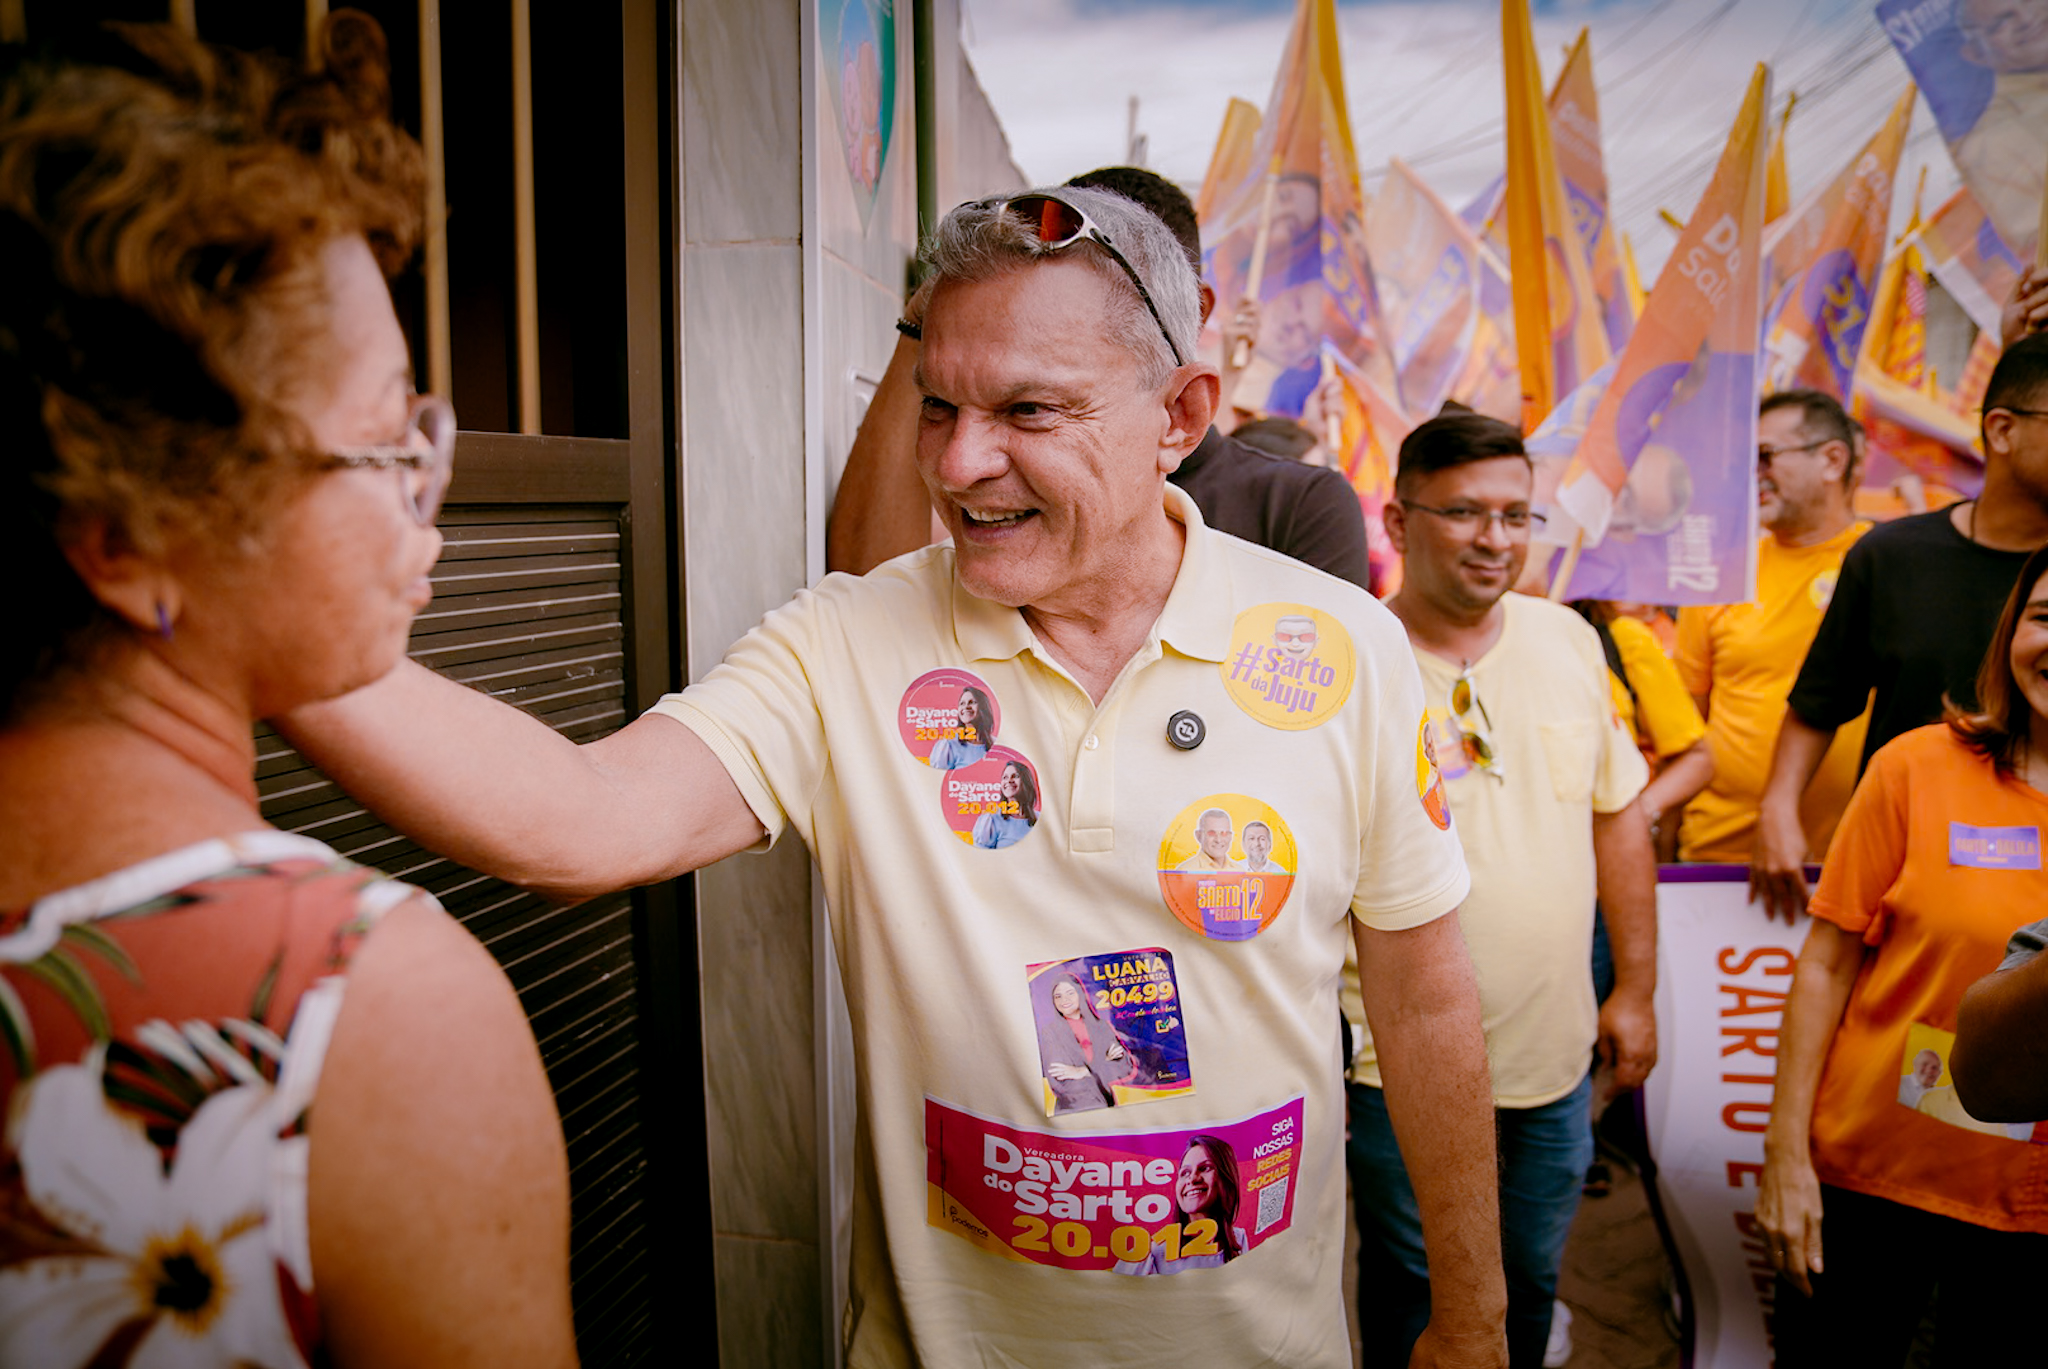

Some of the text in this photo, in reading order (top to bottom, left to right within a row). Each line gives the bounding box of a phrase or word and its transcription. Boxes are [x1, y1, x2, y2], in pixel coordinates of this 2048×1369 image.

[1667, 565, 1719, 592] 12
[1230, 642, 1335, 687] #Sarto
[1250, 674, 1318, 713] da Juju
[906, 706, 959, 719] Dayane
[915, 717, 959, 728] Sarto
[915, 727, 977, 741] 20.012
[949, 780, 1001, 794] Dayane
[958, 791, 1001, 802] Sarto
[957, 801, 1020, 815] 20.012
[1197, 877, 1264, 921] SARTO 12
[1092, 957, 1168, 981] LUANA
[1108, 971, 1170, 988] CARVALHO
[1095, 981, 1176, 1009] 20499
[1271, 1116, 1294, 1136] SIGA
[1023, 1147, 1085, 1161] Vereadora
[1252, 1132, 1294, 1159] NOSSAS
[983, 1133, 1175, 1191] Dayane
[1257, 1147, 1293, 1173] REDES
[1246, 1163, 1290, 1192] SOCIAIS
[983, 1173, 1172, 1223] do Sarto
[951, 1215, 989, 1238] podemos
[1011, 1214, 1219, 1262] 20.012
